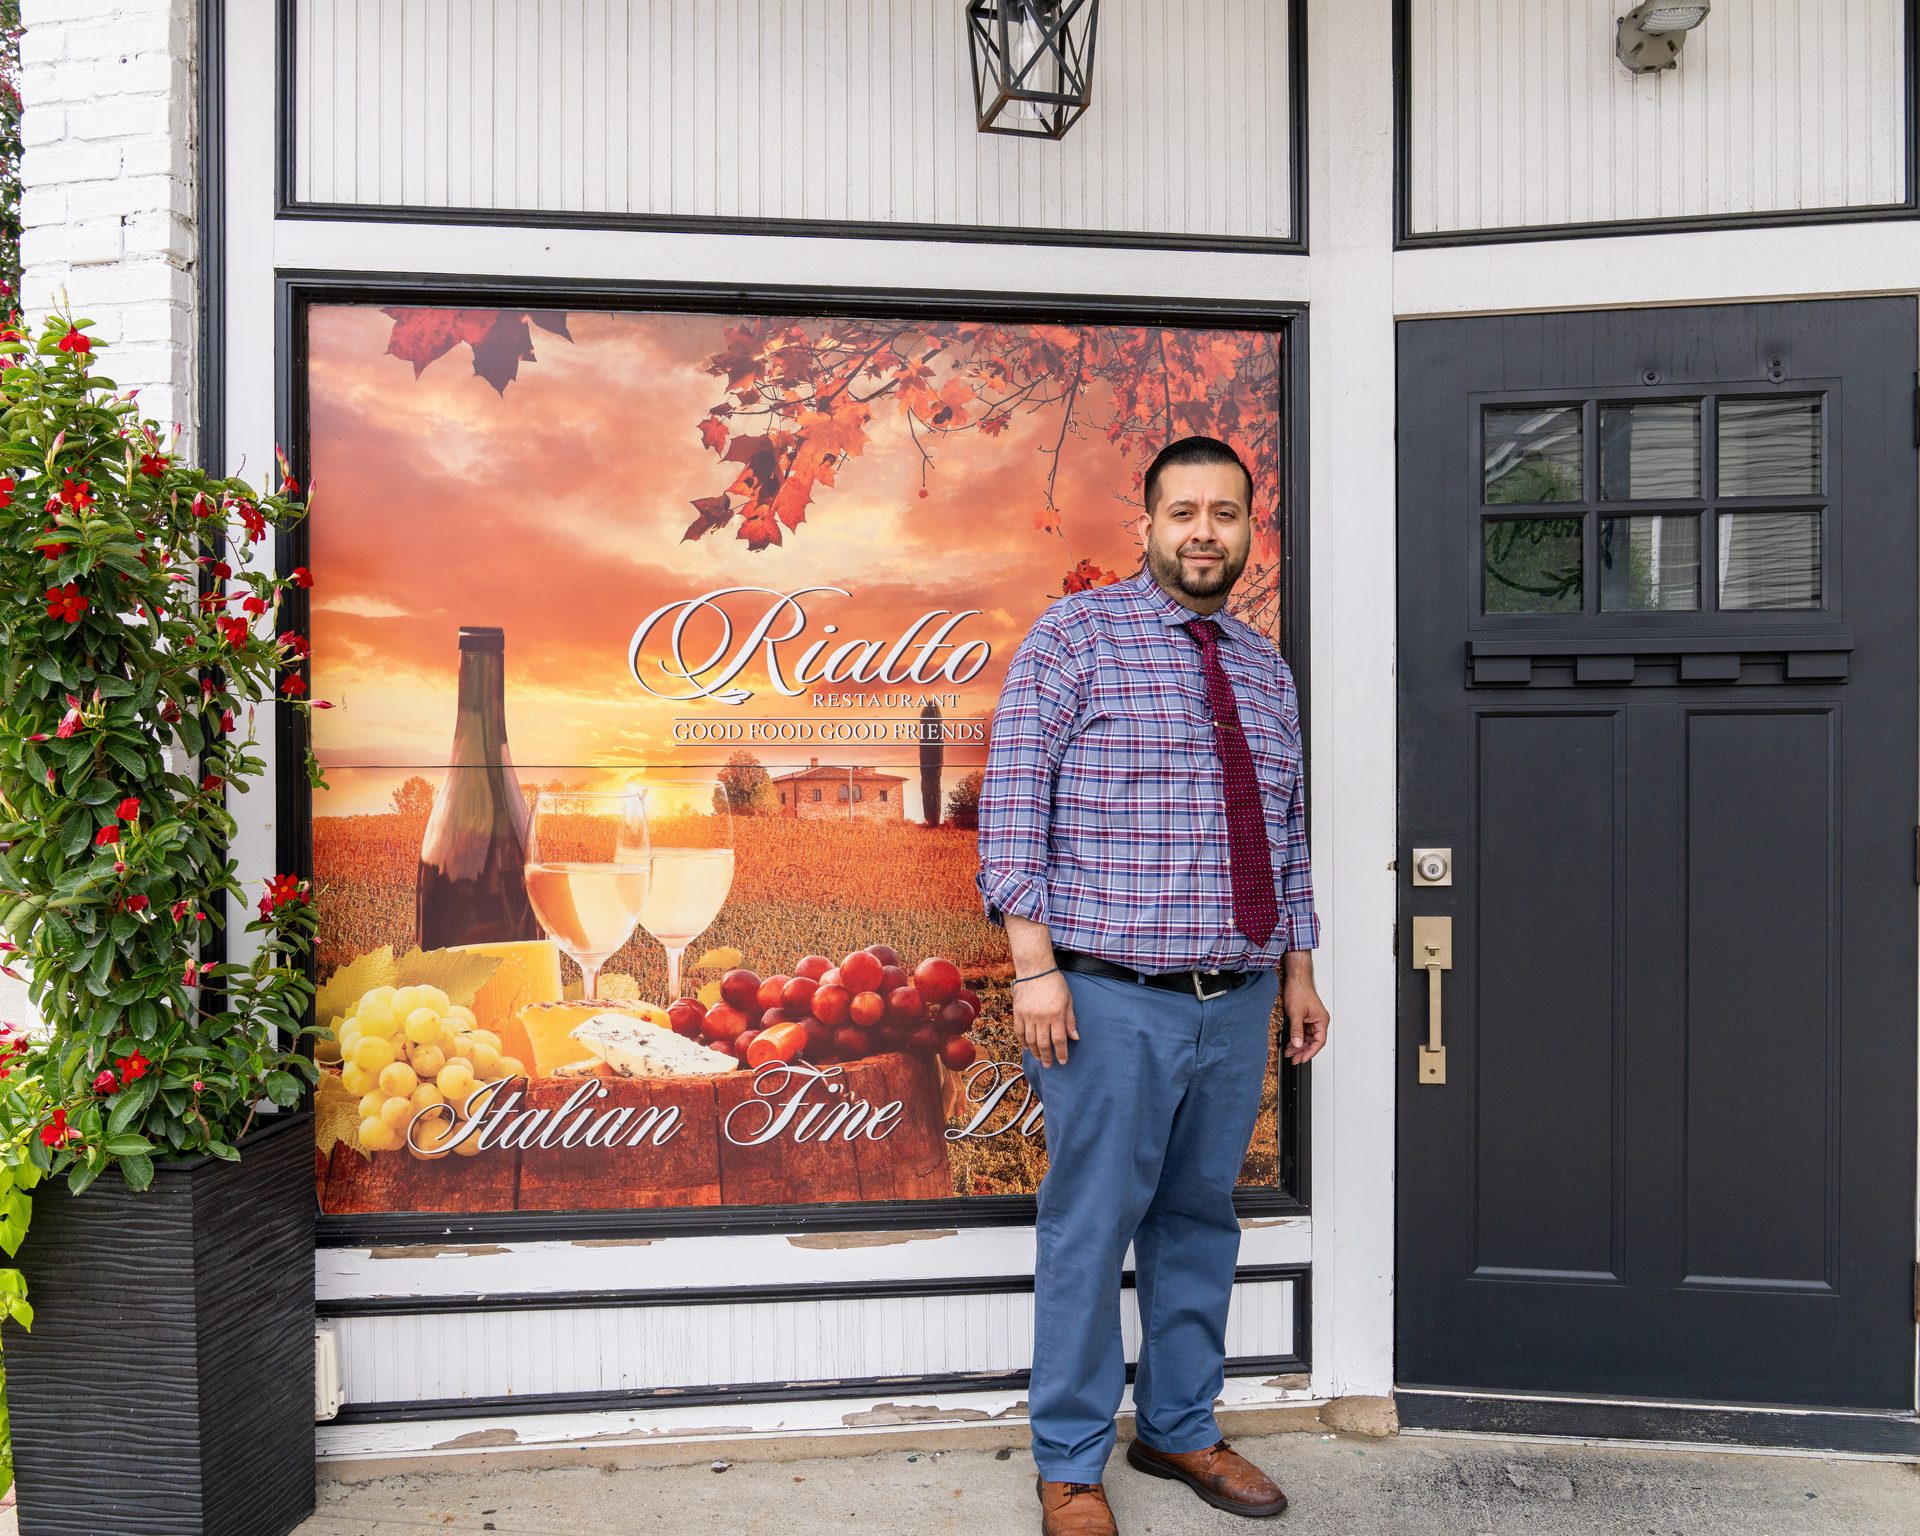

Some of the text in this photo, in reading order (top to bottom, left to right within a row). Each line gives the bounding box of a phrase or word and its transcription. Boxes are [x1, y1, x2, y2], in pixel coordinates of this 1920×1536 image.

[627, 586, 992, 705] Rialto
[812, 693, 962, 708] RESTAURANT
[673, 722, 986, 741] GOOD FOOD GOOD FRIENDS
[407, 1073, 684, 1155] Italian
[724, 1059, 904, 1147] Fine
